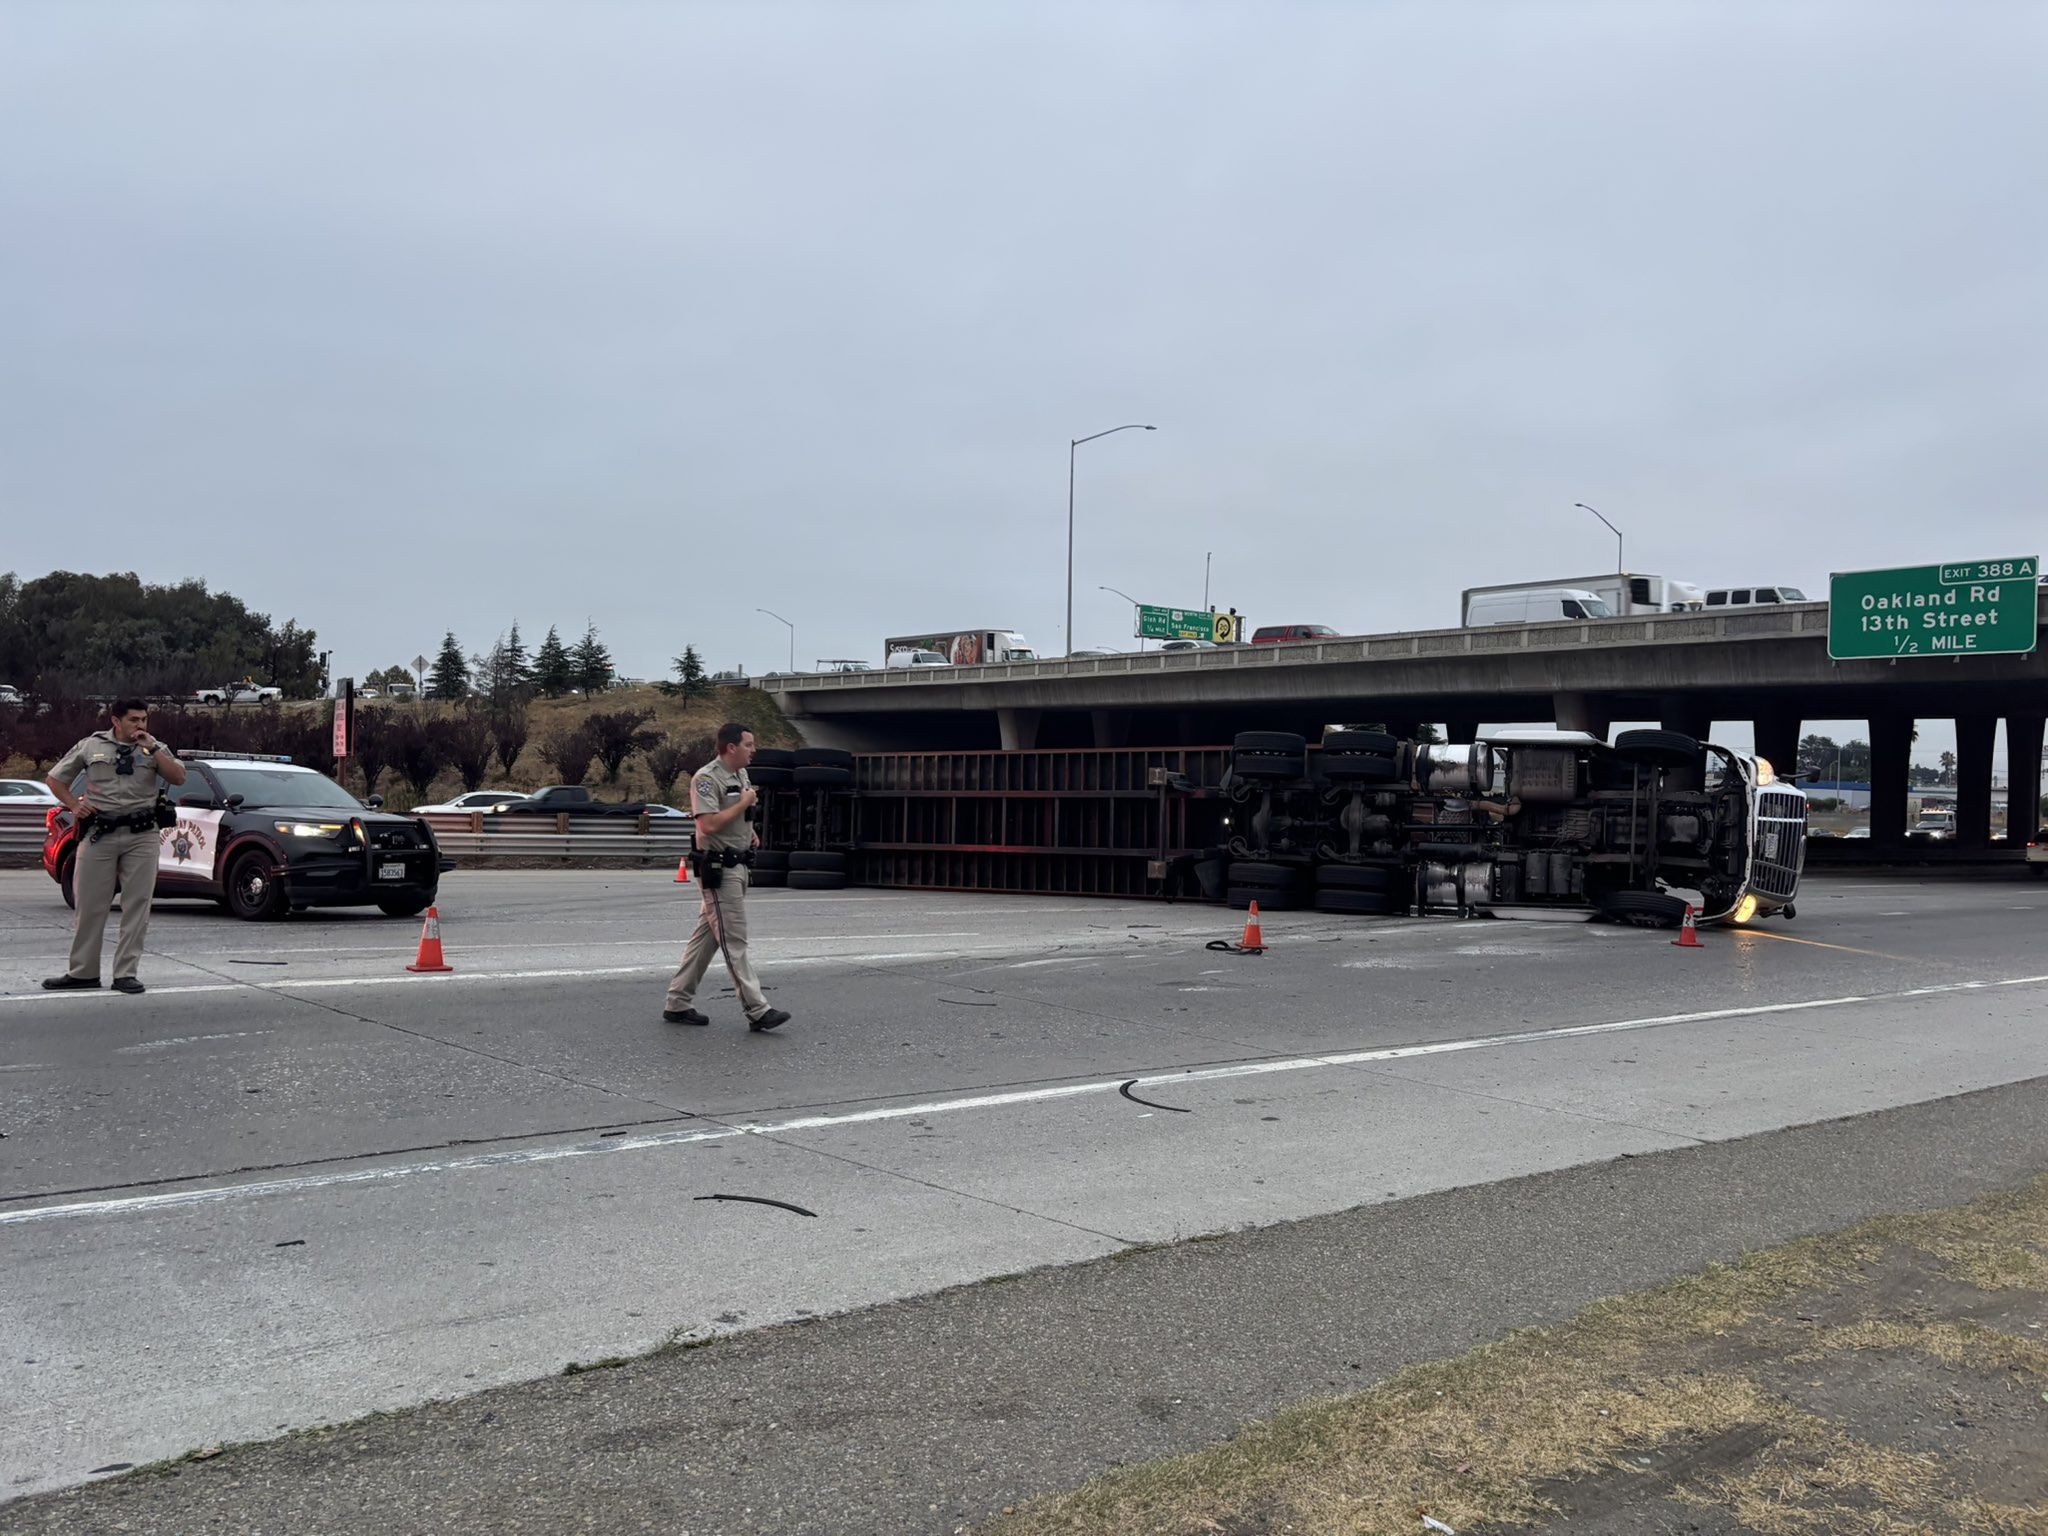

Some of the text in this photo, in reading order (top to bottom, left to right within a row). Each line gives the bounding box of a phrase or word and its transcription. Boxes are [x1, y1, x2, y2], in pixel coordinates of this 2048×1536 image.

[1944, 561, 2033, 579] EXIT 388 A
[1861, 586, 2000, 610] Oakland Rd
[1183, 623, 1209, 632] Francisco
[1861, 608, 1999, 632] 13th Street
[1931, 634, 1977, 650] MILE
[188, 820, 206, 850] PATROL
